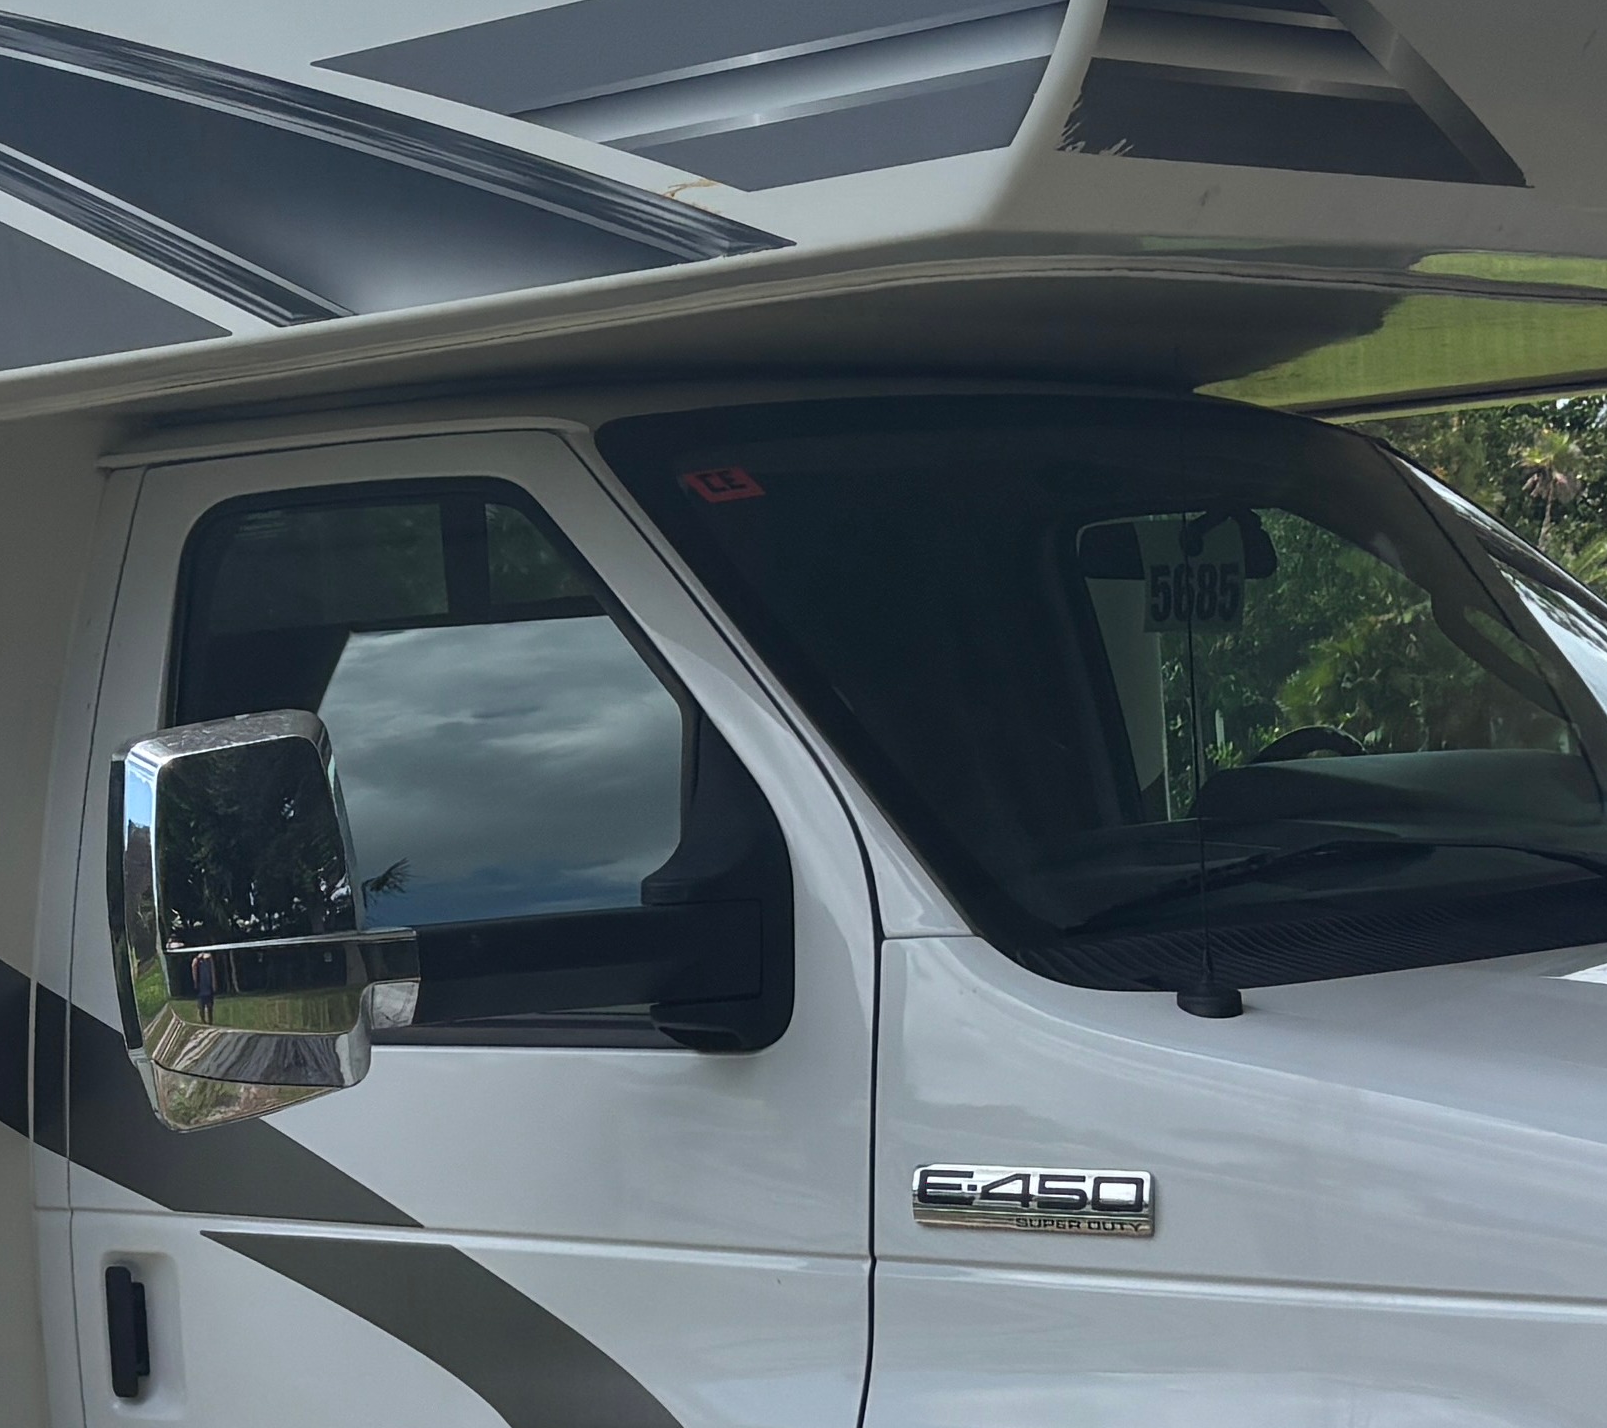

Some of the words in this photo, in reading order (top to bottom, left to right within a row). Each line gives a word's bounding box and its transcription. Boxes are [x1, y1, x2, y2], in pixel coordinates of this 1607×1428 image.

[1149, 562, 1240, 622] 5685
[918, 1168, 1145, 1213] E-450
[1015, 1217, 1081, 1230] SUPER
[1087, 1220, 1144, 1232] DUTY
